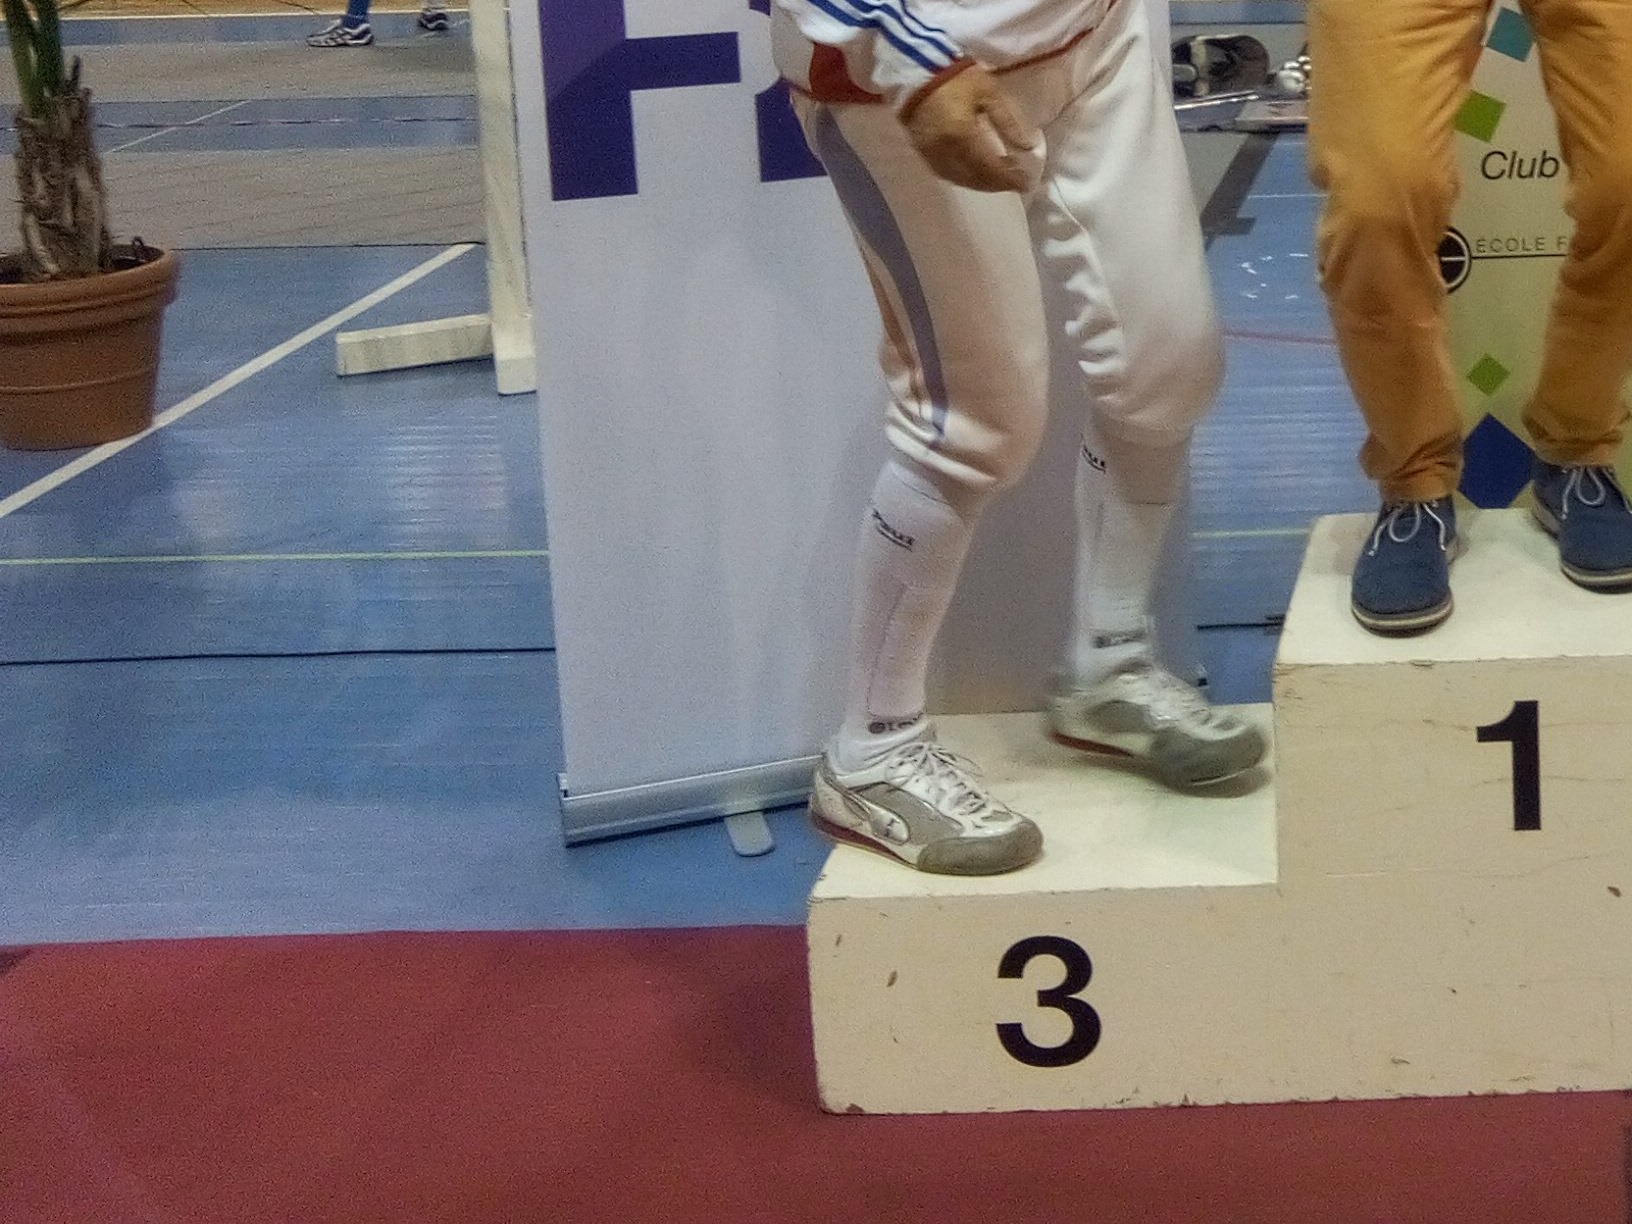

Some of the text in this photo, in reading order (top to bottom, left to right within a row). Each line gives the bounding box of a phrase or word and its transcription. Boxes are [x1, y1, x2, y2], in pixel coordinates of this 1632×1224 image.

[1481, 150, 1560, 180] Club
[1475, 237, 1545, 253] ECOLE
[1476, 699, 1542, 831] 1
[995, 935, 1102, 1068] 3
